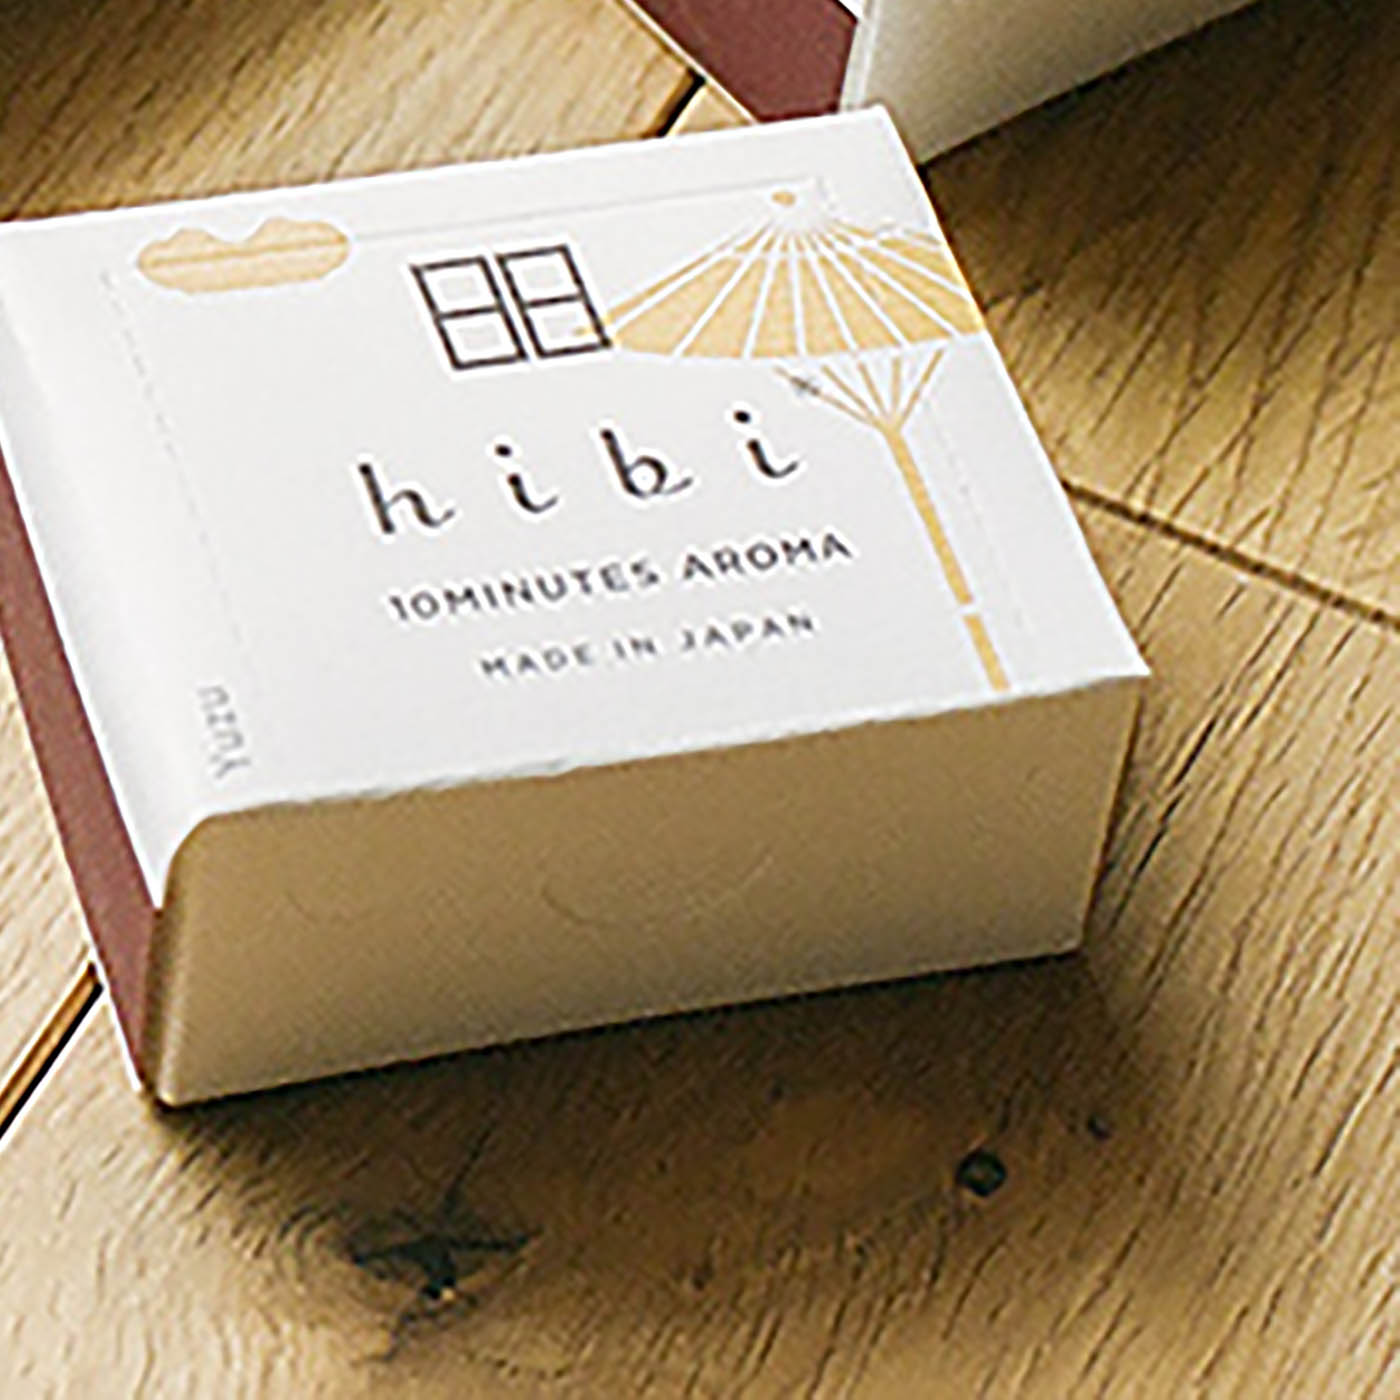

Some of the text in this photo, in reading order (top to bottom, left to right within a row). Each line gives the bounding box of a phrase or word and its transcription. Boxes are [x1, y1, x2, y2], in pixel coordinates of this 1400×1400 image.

[356, 409, 801, 536] hibi
[388, 531, 855, 623] 10MINUTES AROMA
[479, 612, 816, 681] MADE IN JAPAN
